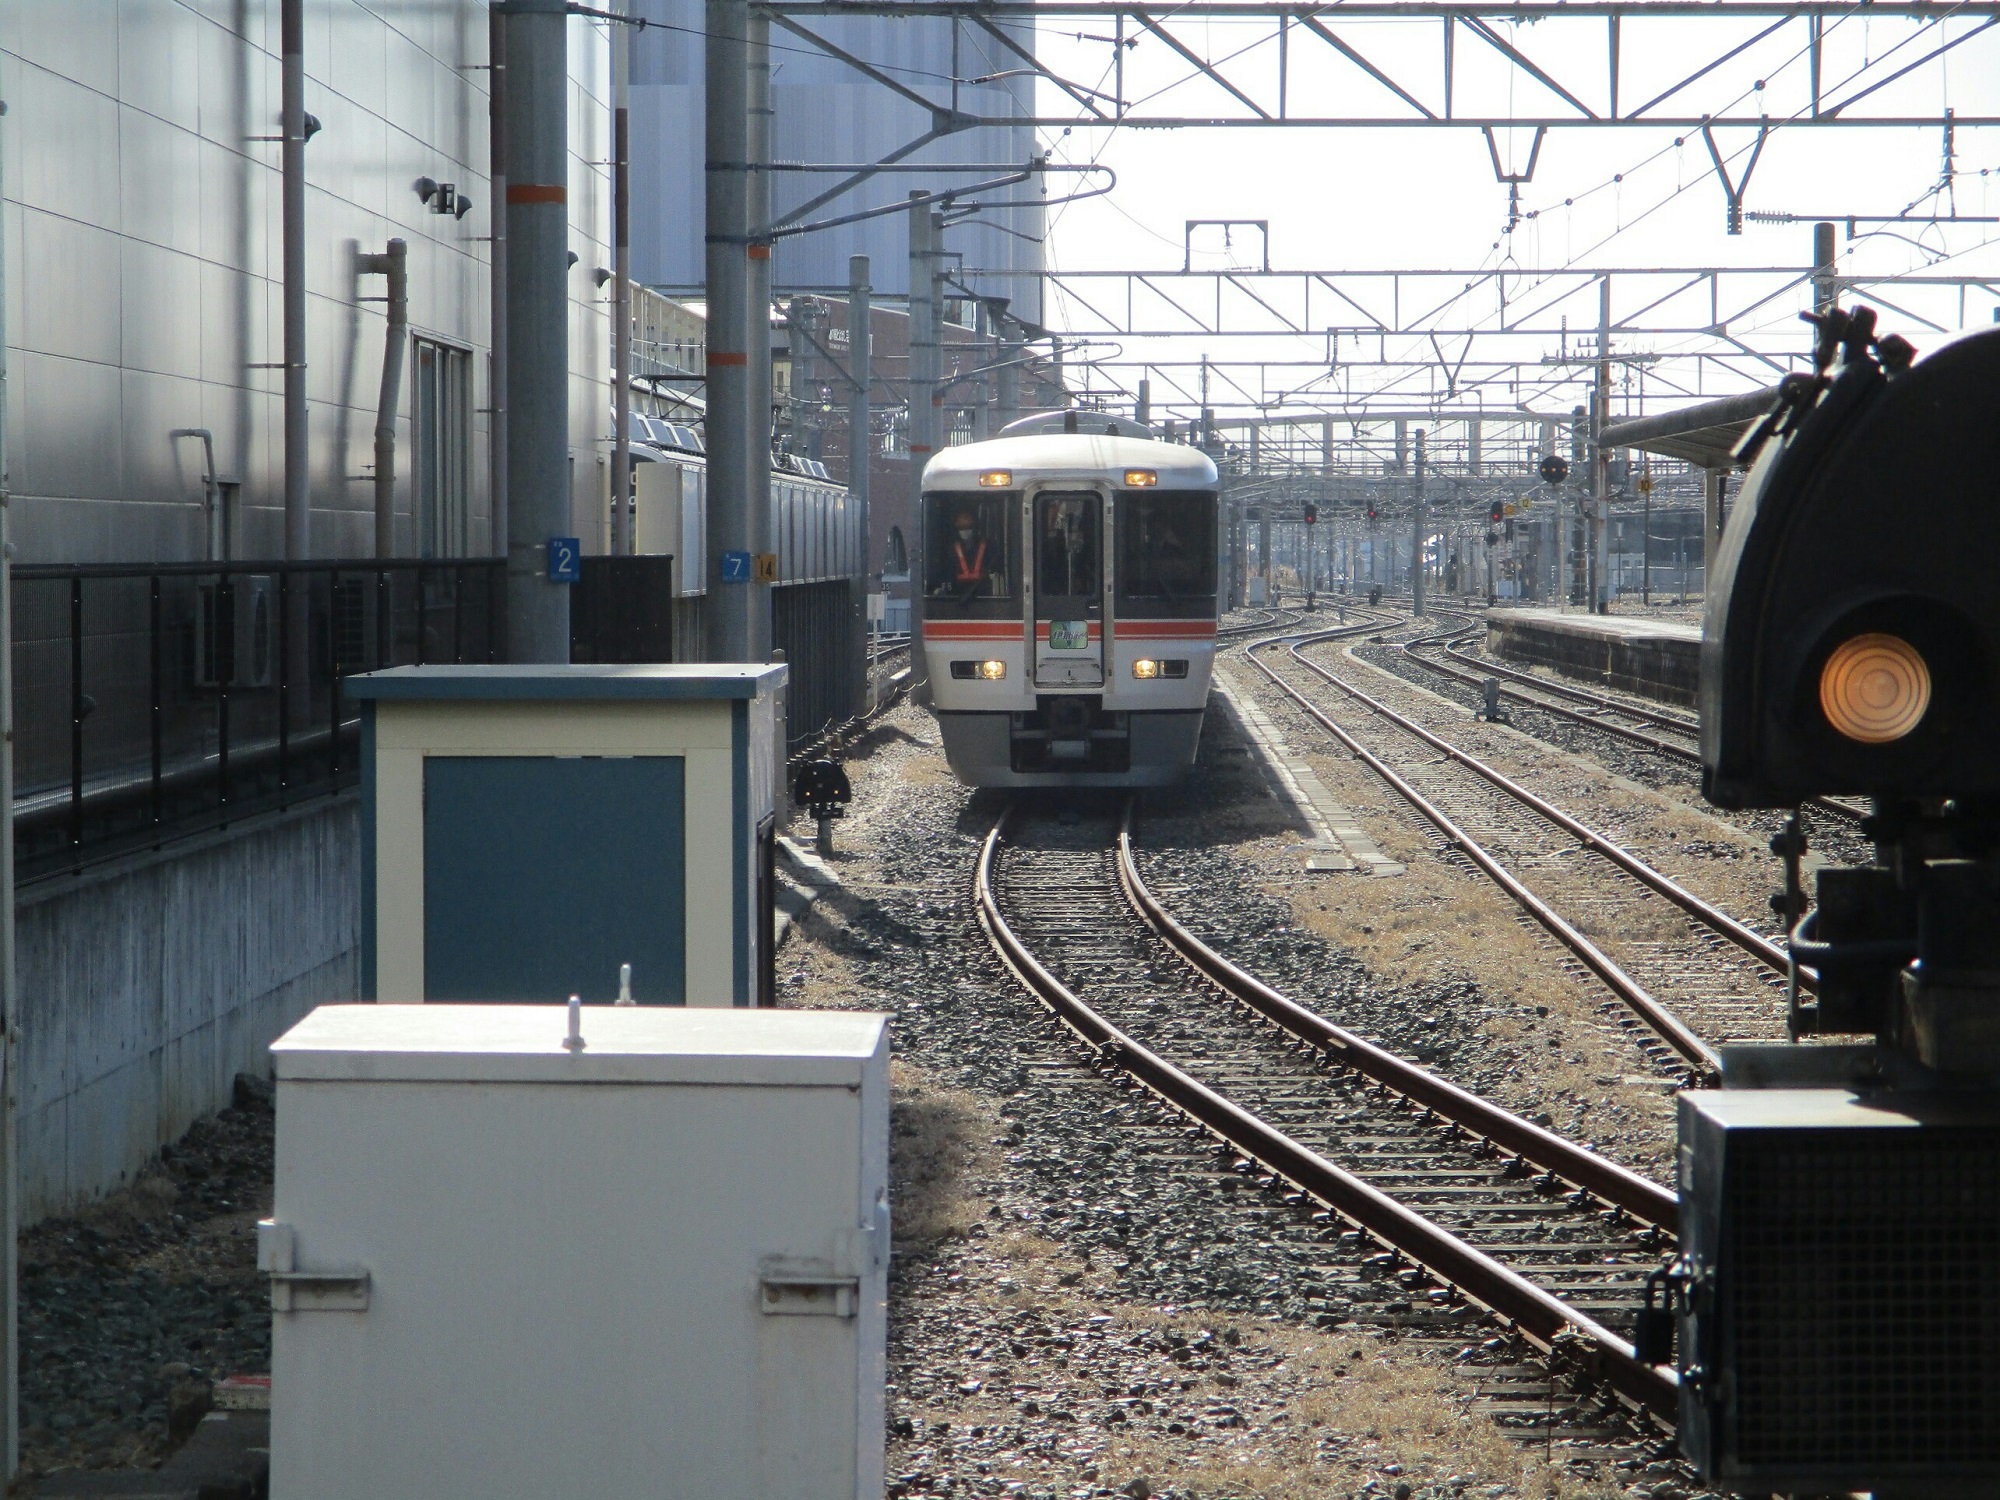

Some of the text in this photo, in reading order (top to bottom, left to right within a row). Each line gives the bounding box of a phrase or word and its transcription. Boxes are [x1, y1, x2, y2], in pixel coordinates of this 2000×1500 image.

[1640, 479, 1650, 491] 10
[559, 547, 572, 572] 2
[730, 558, 742, 576] 7
[760, 560, 773, 577] 14
